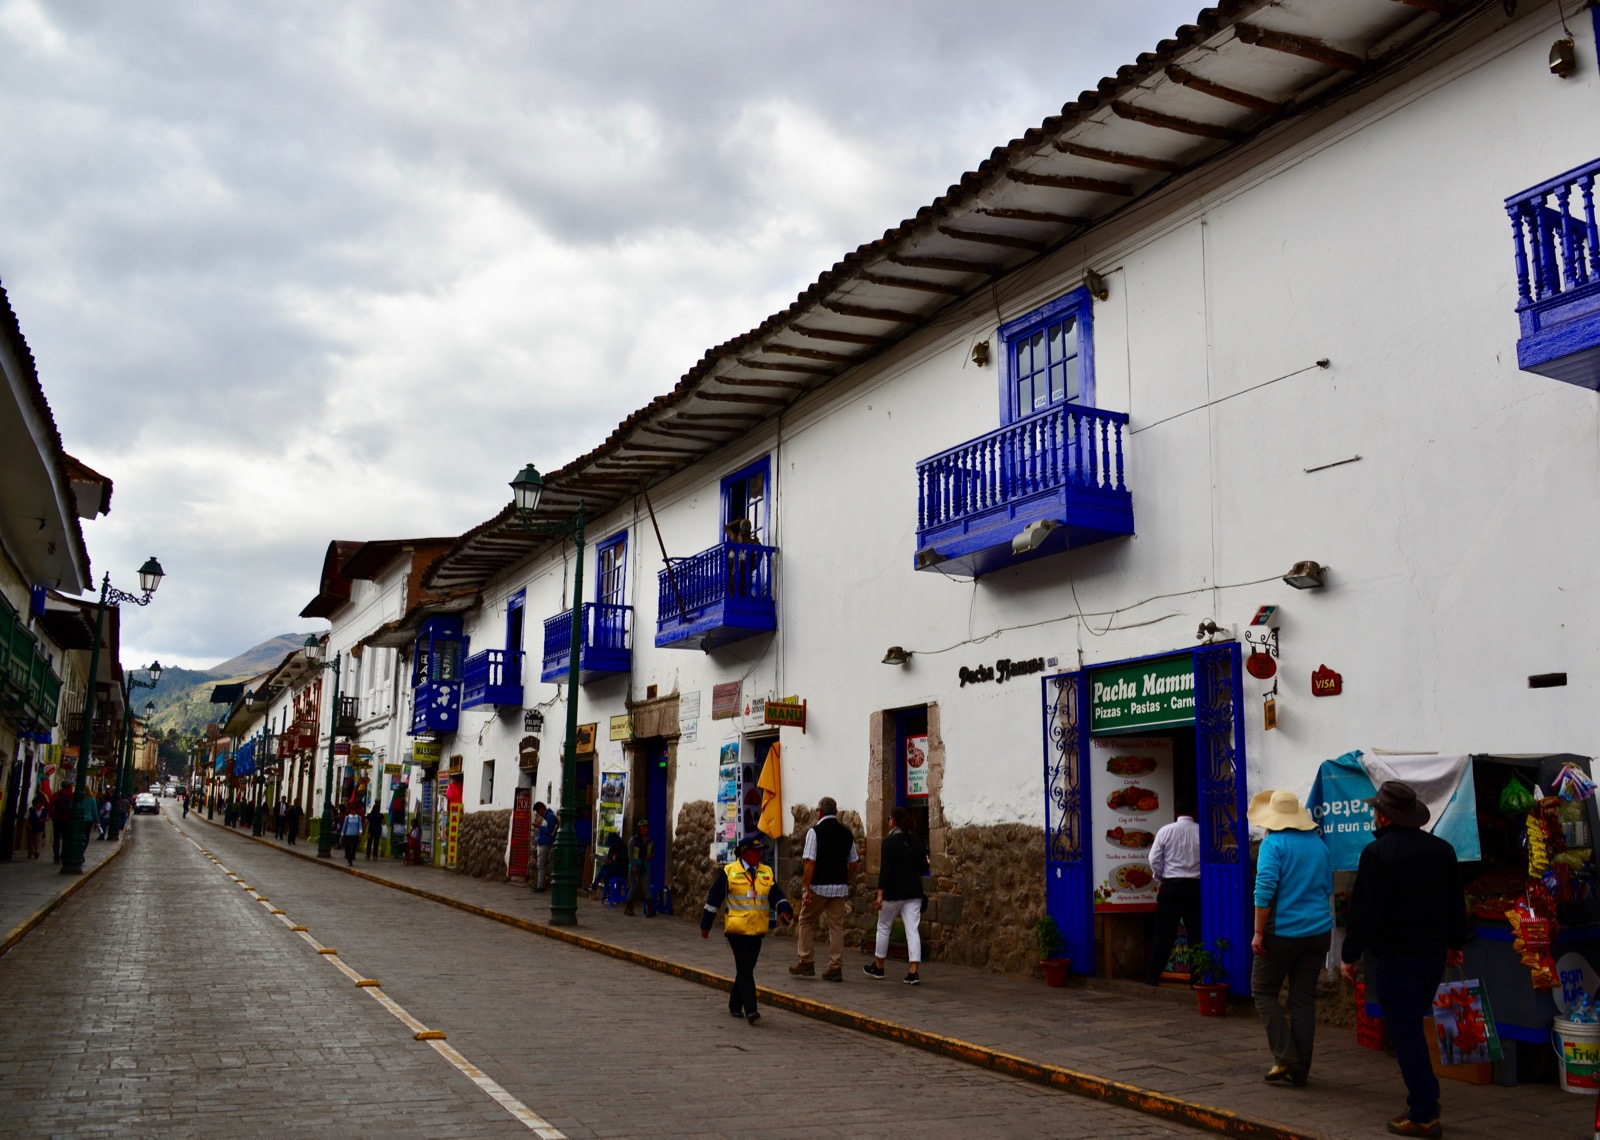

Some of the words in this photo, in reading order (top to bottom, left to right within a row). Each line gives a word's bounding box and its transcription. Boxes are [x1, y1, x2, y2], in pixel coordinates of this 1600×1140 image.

[959, 664, 994, 688] Pacha
[1093, 678, 1137, 704] Pacha
[1142, 672, 1195, 697] Mamm
[1315, 679, 1335, 689] VISA
[767, 706, 803, 720] MANU
[1095, 707, 1121, 719] Pizzas
[1130, 701, 1160, 715] Pastas
[1170, 696, 1196, 709] Carne
[416, 747, 440, 756] MASSAGE
[450, 805, 460, 863] MARKET
[1337, 822, 1360, 833] una
[1363, 821, 1377, 833] ge
[1560, 968, 1583, 984] san
